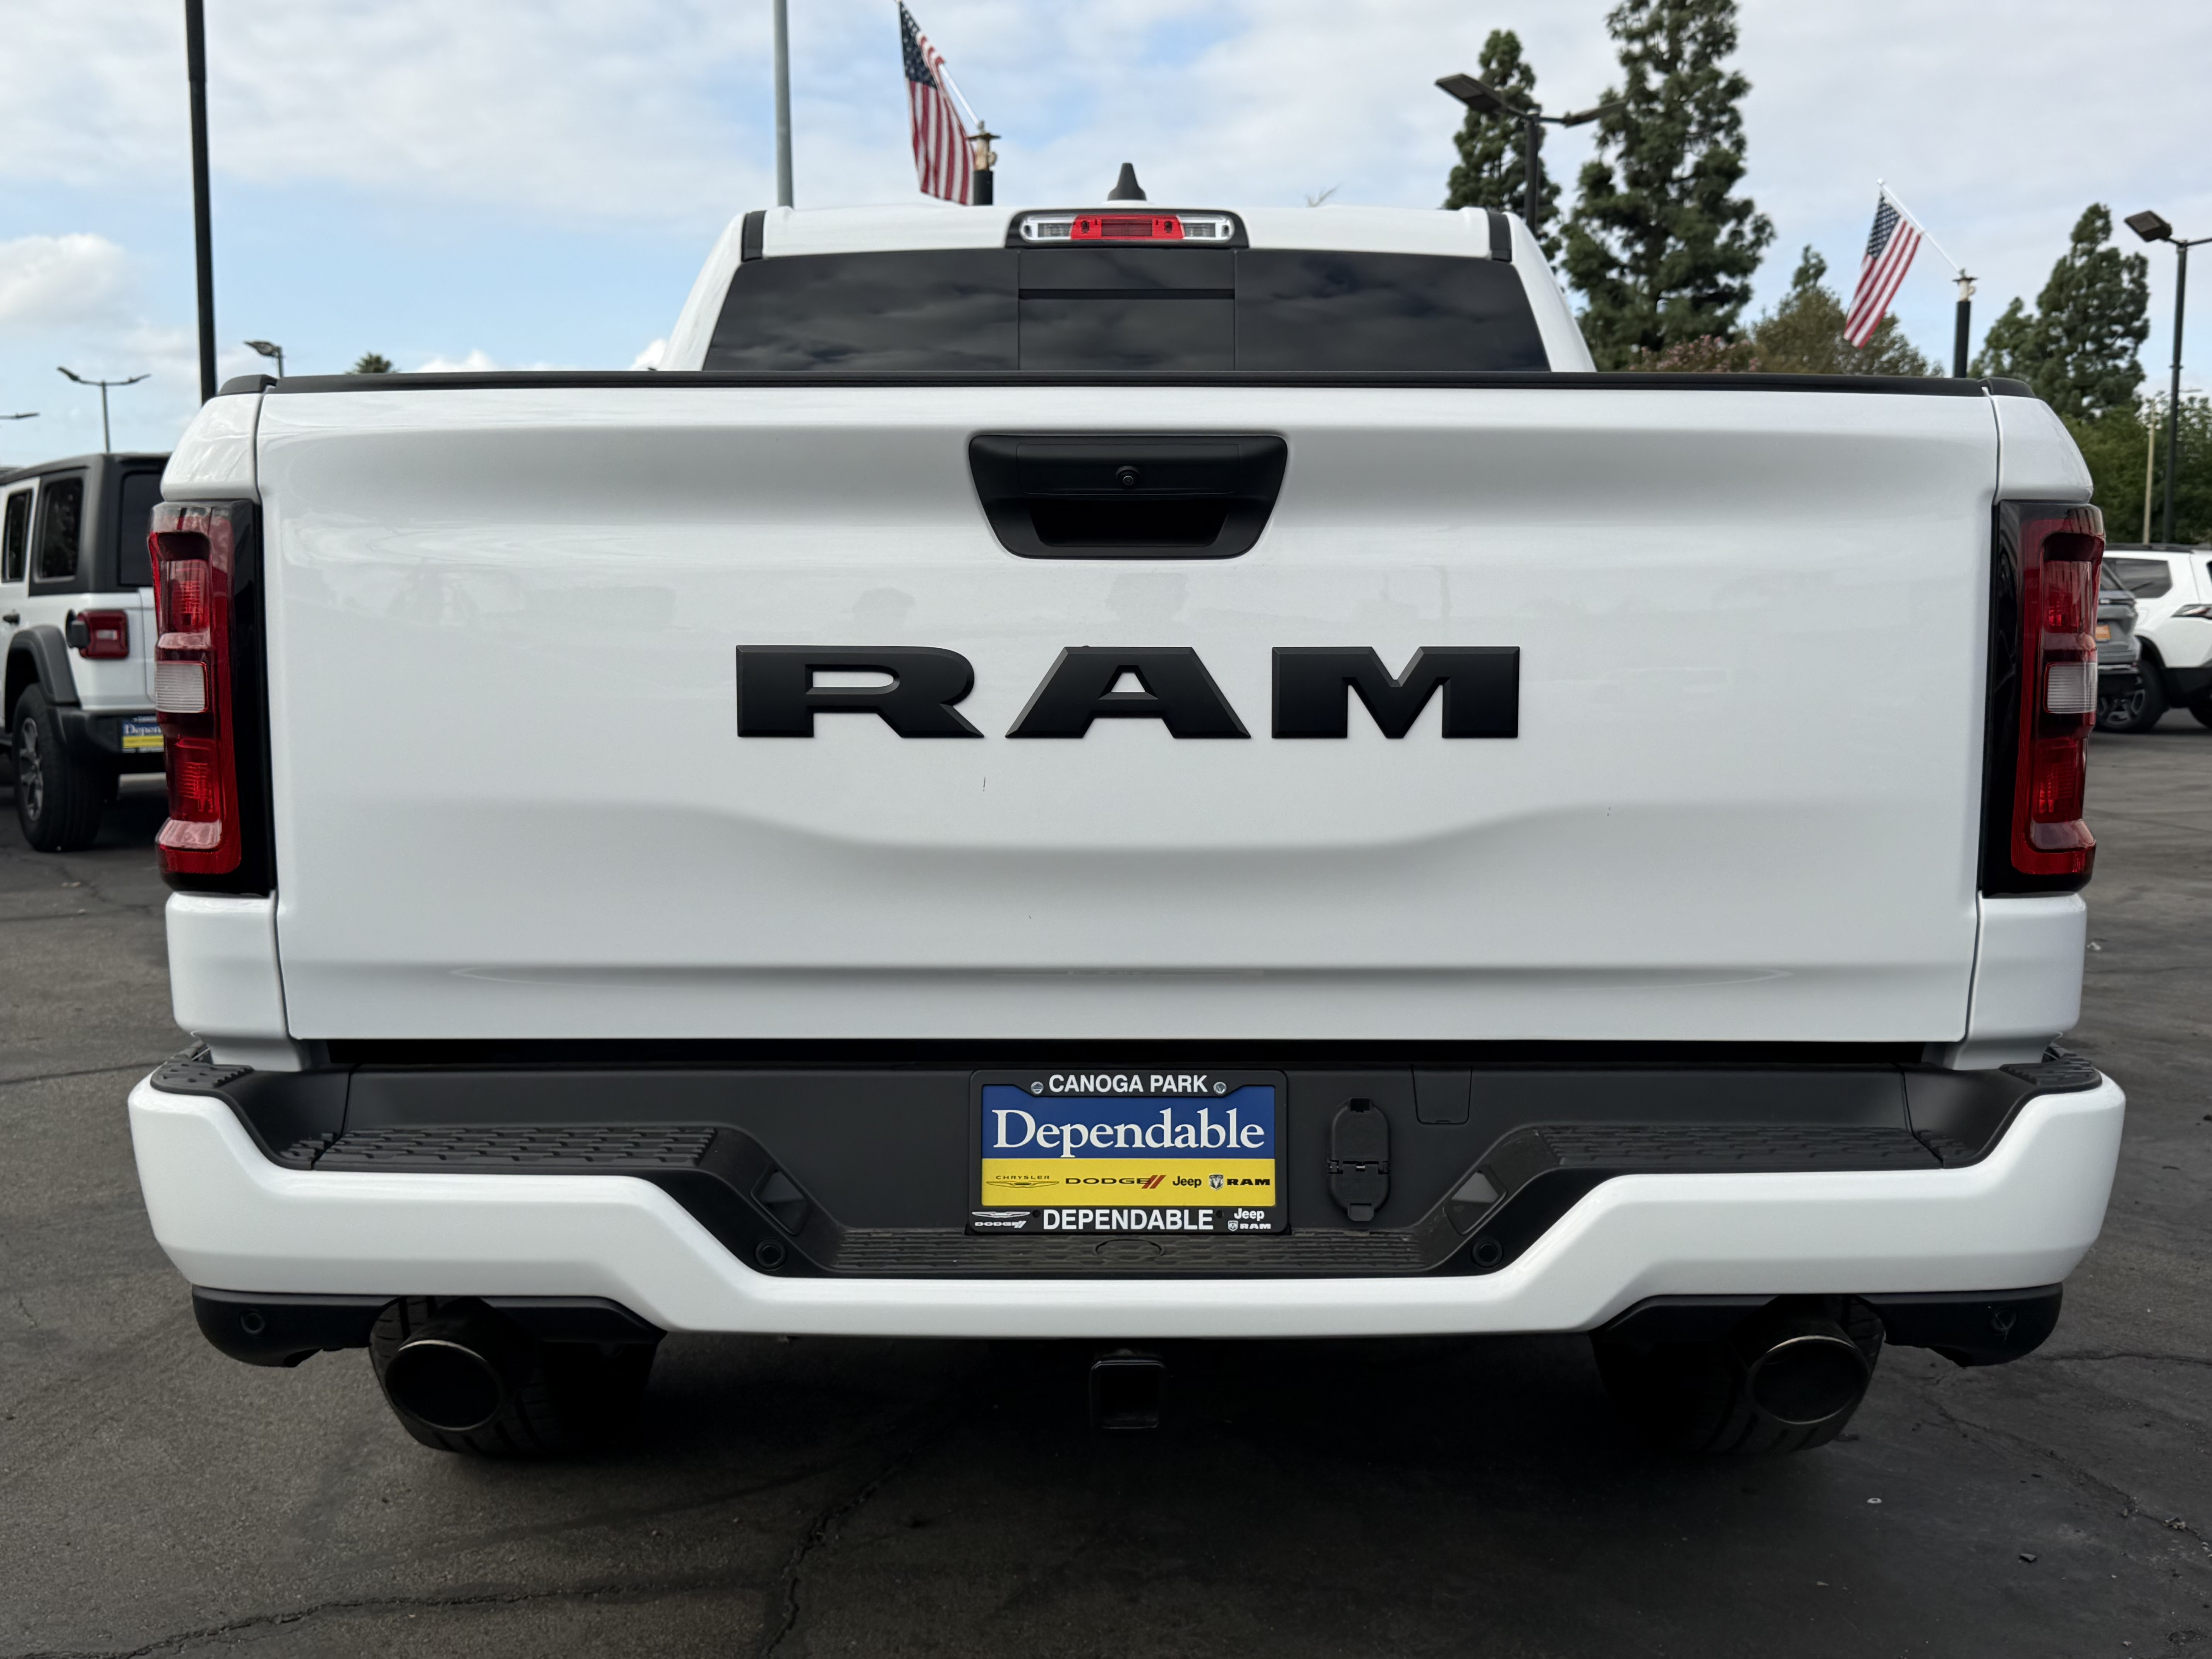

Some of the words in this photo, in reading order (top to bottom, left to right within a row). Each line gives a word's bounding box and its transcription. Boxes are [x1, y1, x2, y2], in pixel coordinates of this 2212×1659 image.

[736, 645, 1520, 739] RAM
[124, 723, 161, 736] Depen
[1049, 1074, 1144, 1092] CANOGA
[1150, 1075, 1208, 1092] PARK
[992, 1108, 1264, 1158] Dependable
[1172, 1176, 1202, 1188] Jeep
[1043, 1209, 1214, 1230] DEPENDABLE
[1233, 1208, 1265, 1221] Jeep
